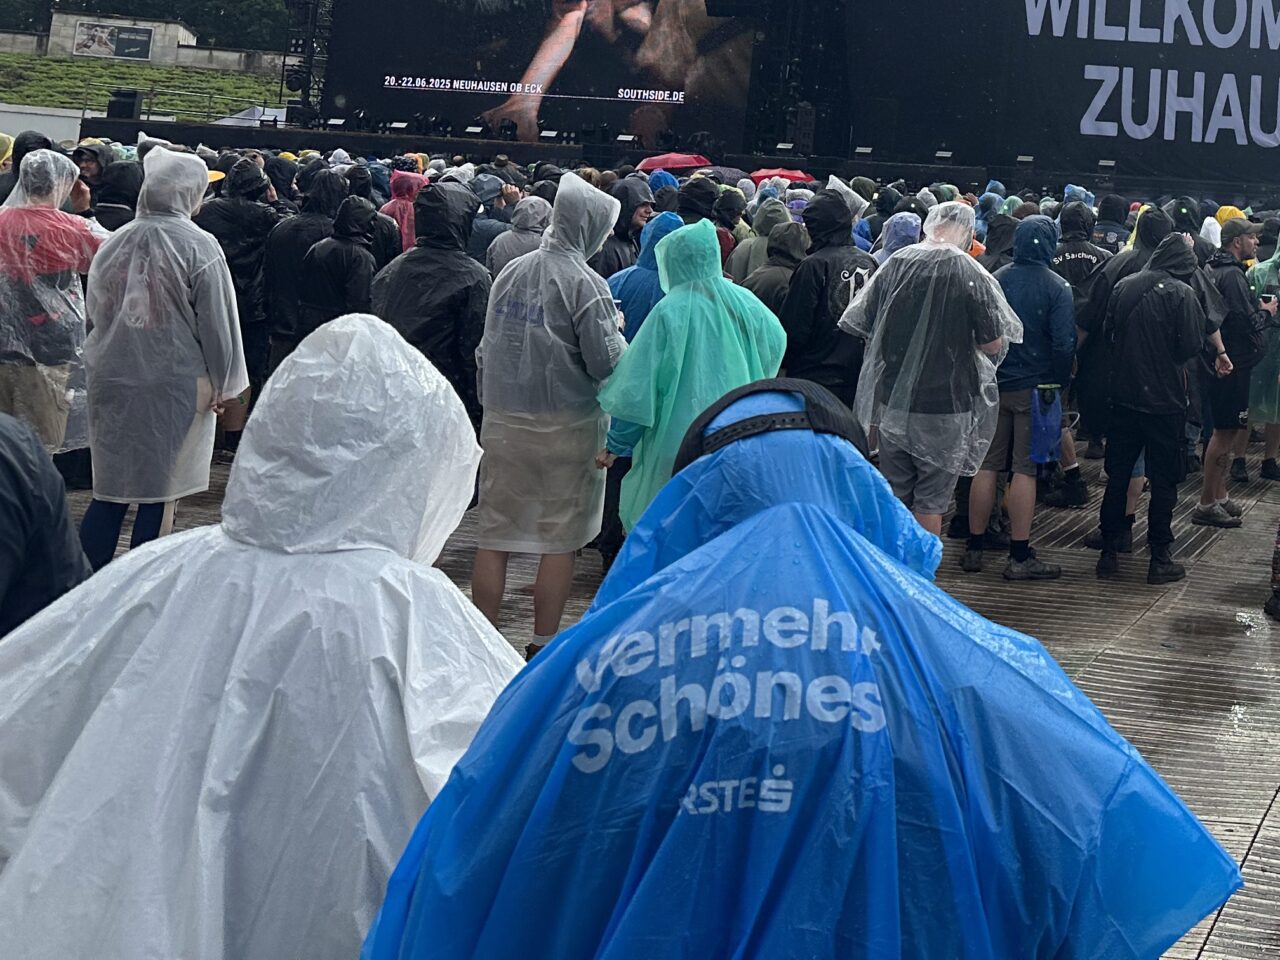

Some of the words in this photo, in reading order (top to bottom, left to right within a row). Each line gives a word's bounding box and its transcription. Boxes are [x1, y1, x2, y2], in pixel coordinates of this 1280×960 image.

[384, 76, 451, 89] 20.-22.06.2025
[453, 79, 508, 92] NEUHAUSEN
[510, 82, 523, 93] OB
[524, 83, 543, 94] ECK
[617, 88, 685, 101] SOUTHSIDE.DE
